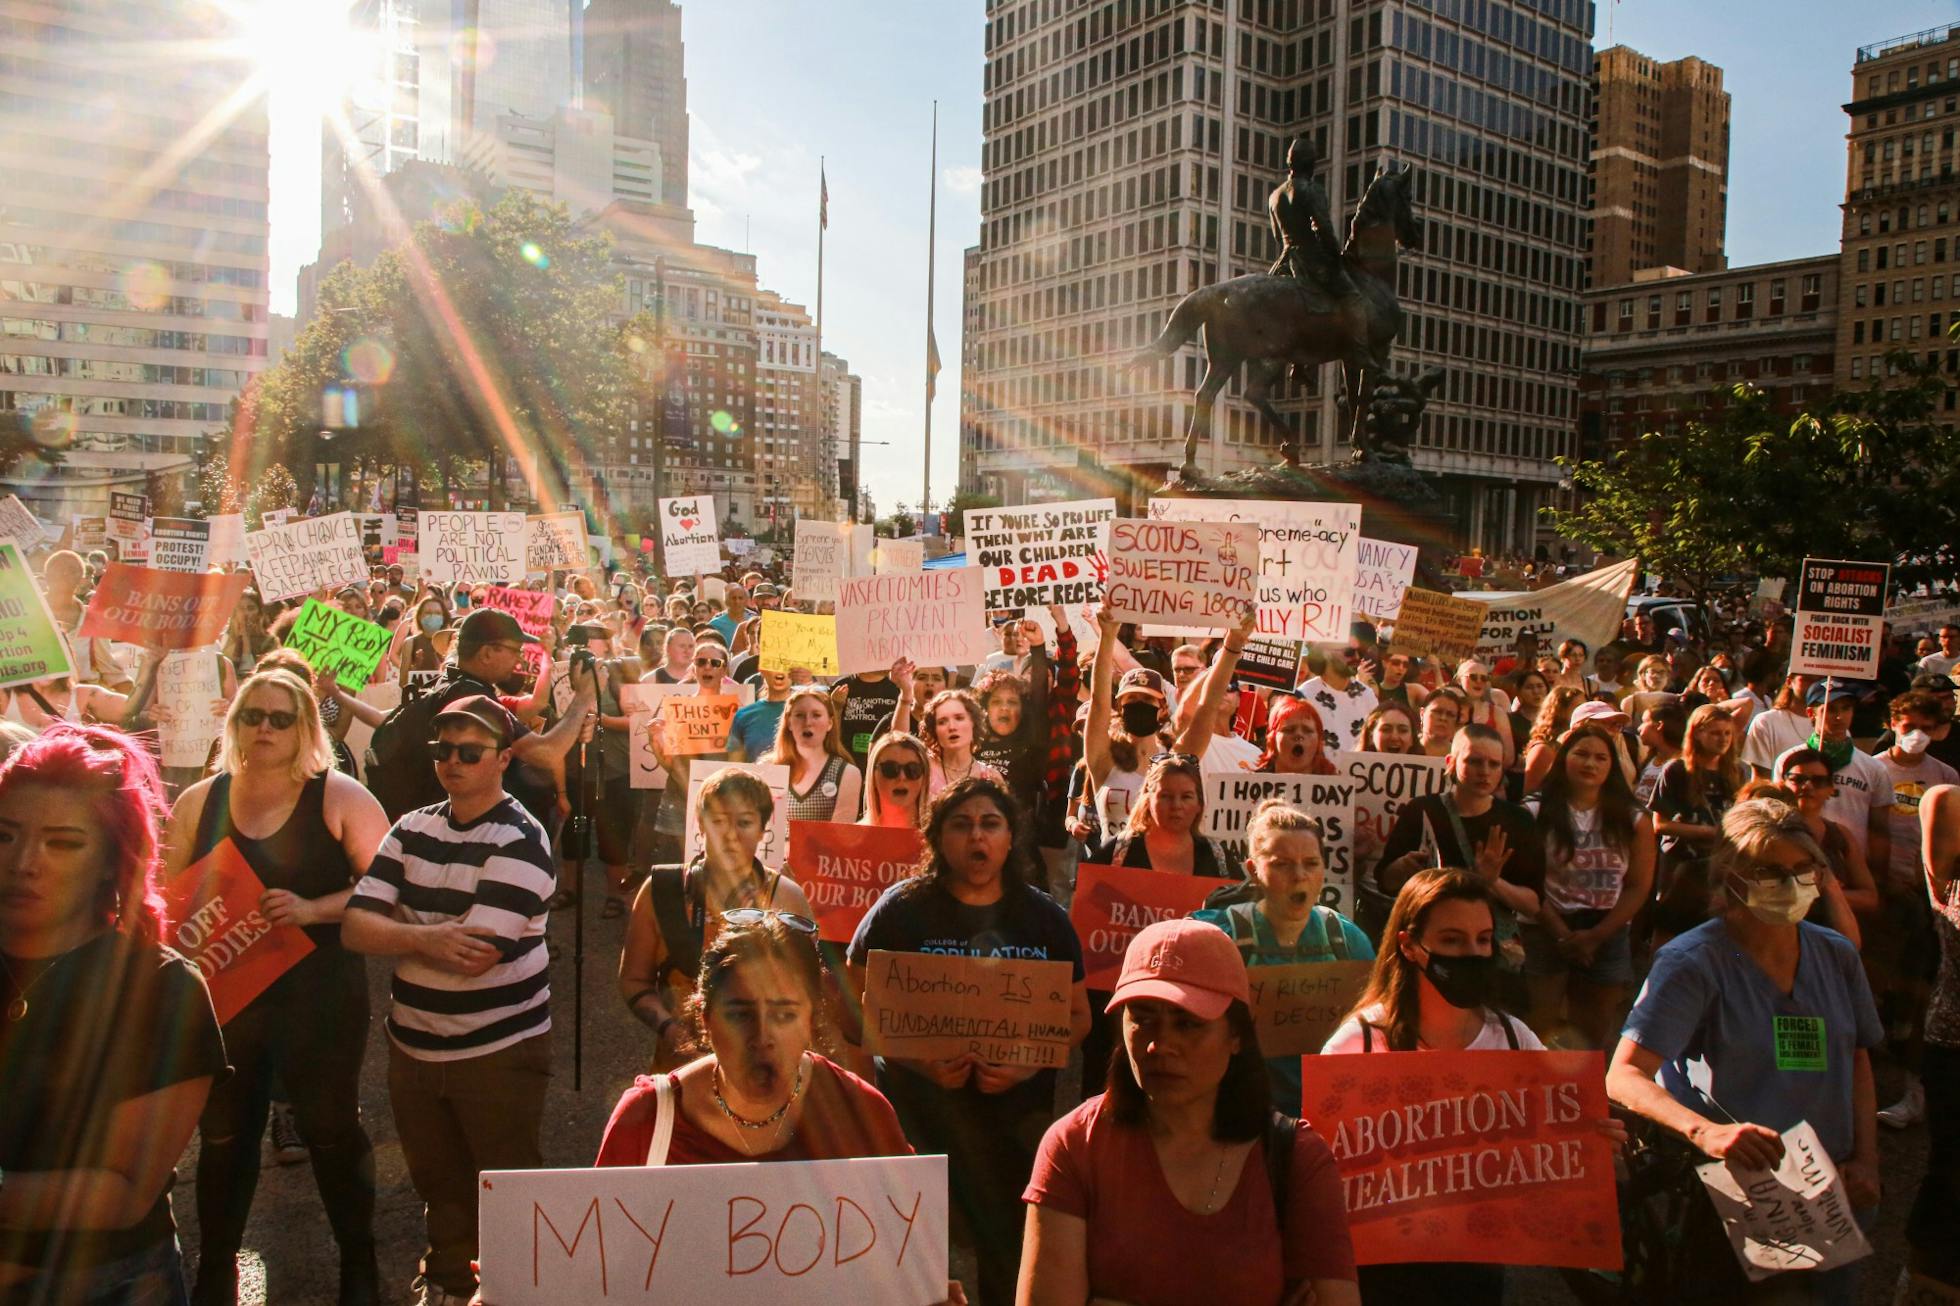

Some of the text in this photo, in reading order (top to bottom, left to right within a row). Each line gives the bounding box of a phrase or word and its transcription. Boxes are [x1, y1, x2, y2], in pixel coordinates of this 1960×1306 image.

[669, 500, 698, 517] God
[428, 514, 498, 532] PEOPLE
[971, 515, 993, 531] IF
[1043, 512, 1060, 529] SO
[1062, 511, 1083, 526] PRO
[1085, 510, 1113, 524] LIFE
[156, 541, 204, 555] PROTEST!
[439, 532, 504, 546] ARE NOT
[665, 533, 715, 547] Abortion
[972, 526, 1098, 549] THEN WHY ARE
[1114, 524, 1203, 554] SCOTUS,
[156, 554, 200, 567] OCCUPY!
[436, 546, 517, 563] POLITICAL
[979, 543, 1097, 567] OUR CHILDREN
[1258, 549, 1292, 576] rt
[255, 554, 300, 580] KEEP
[453, 563, 509, 580] PAWNS
[999, 561, 1079, 587] DEAD
[1808, 567, 1835, 580] STOP
[840, 571, 961, 607] VASECTOMIES
[1223, 567, 1252, 591] UR
[1810, 582, 1878, 597] ON ABORTION
[126, 591, 181, 611] BANS
[1108, 583, 1194, 616] GIVING
[1260, 581, 1327, 604] us who
[1824, 597, 1860, 609] RIGHTS
[104, 606, 152, 626] OUR
[304, 604, 351, 641] MY
[867, 601, 965, 633] PREVENT
[1810, 614, 1869, 626] FIGHT BACK WITH
[1480, 627, 1512, 639] FOR
[1803, 625, 1873, 644] SOCIALIST
[866, 632, 969, 662] ABORTIONS
[1269, 646, 1282, 657] FOR
[1801, 642, 1871, 661] FEMINISM
[1257, 655, 1276, 666] CHILD
[671, 703, 710, 719] THIS
[1219, 781, 1225, 800] I
[1293, 783, 1302, 804] 1
[1312, 784, 1354, 806] DAY
[817, 855, 872, 881] BANS
[802, 881, 845, 906] OUR
[176, 896, 229, 949] OFF
[1109, 902, 1175, 929] BANS
[1089, 929, 1131, 955] OU
[886, 958, 1065, 1003] Abortion IS a
[1276, 977, 1341, 998] RIGHT
[879, 1009, 1072, 1037] FUNDAMENTAL HUMAN
[969, 1041, 1056, 1064] RIGHT!!!
[1332, 1082, 1581, 1160] ABORTION IS
[533, 1192, 922, 1296] MY BODY
